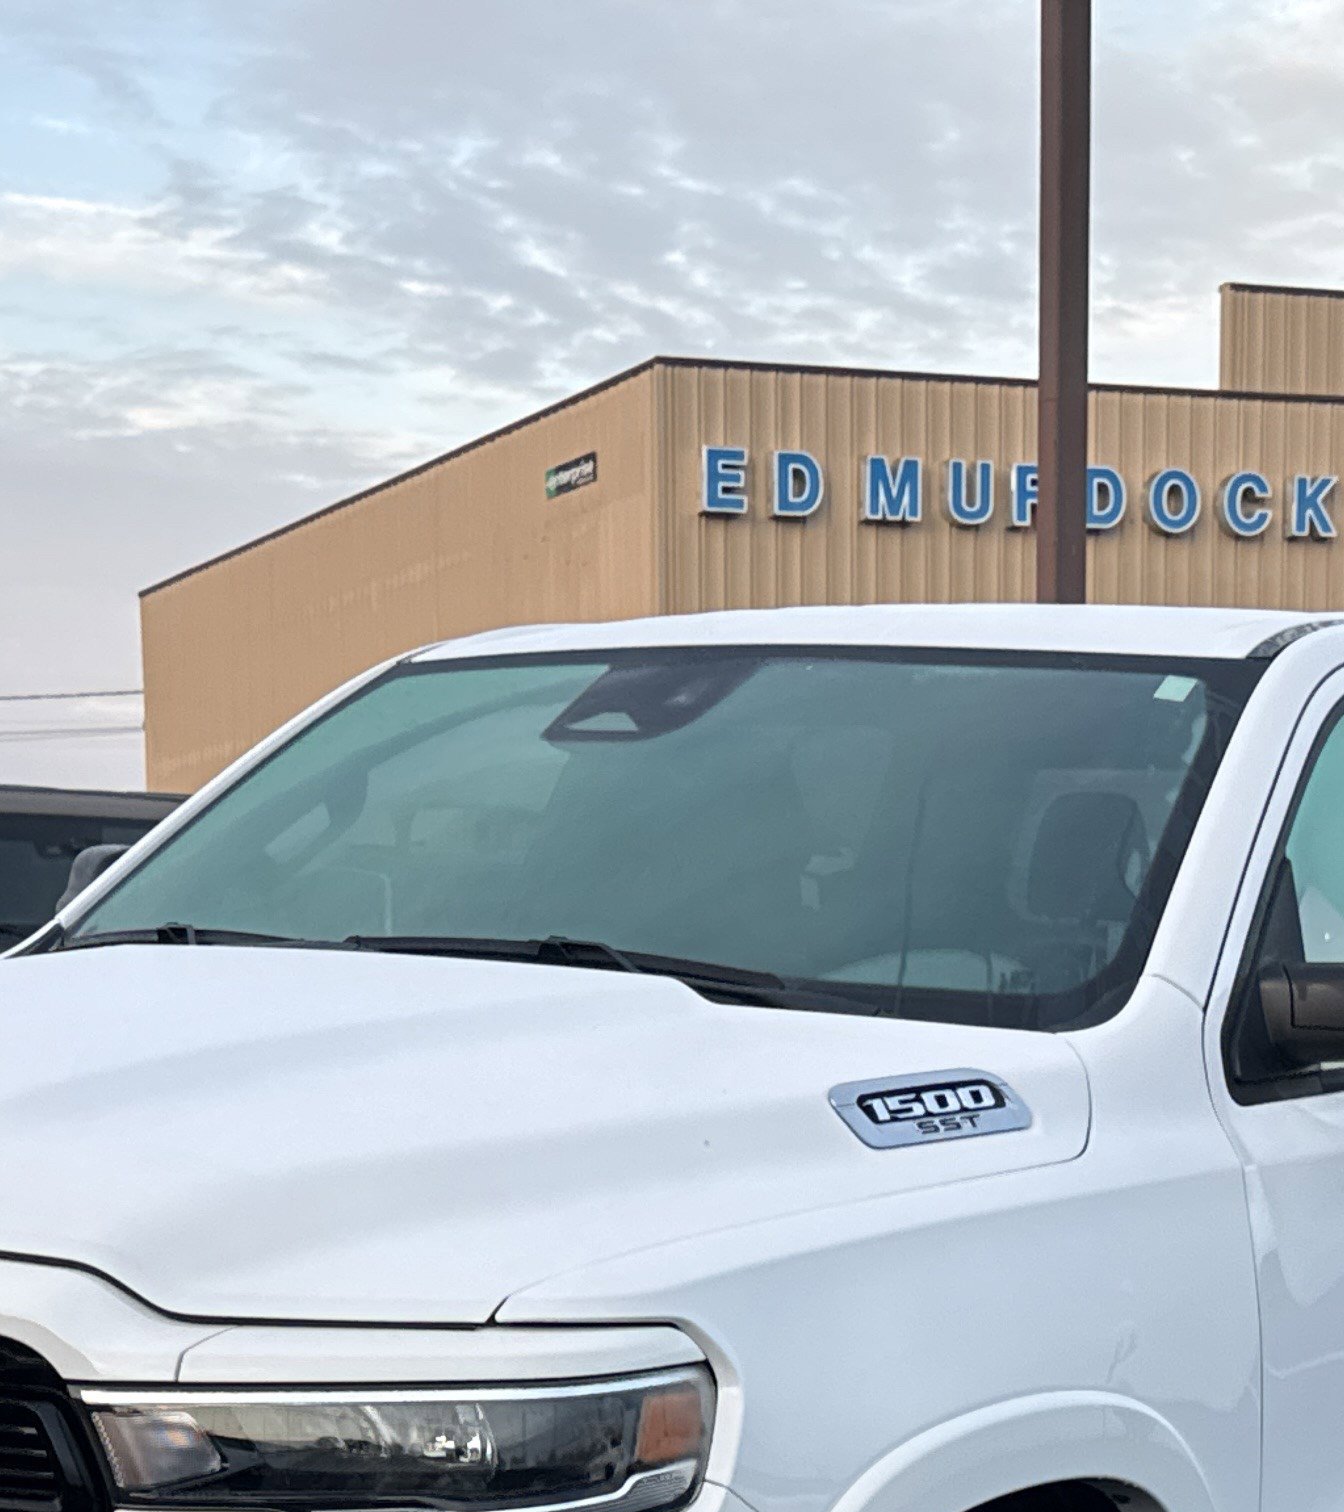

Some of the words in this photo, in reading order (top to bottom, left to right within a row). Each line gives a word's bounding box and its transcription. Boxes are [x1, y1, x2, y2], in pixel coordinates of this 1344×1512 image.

[702, 446, 824, 517] ED
[862, 1084, 996, 1122] 1500
[915, 1114, 981, 1135] SST
